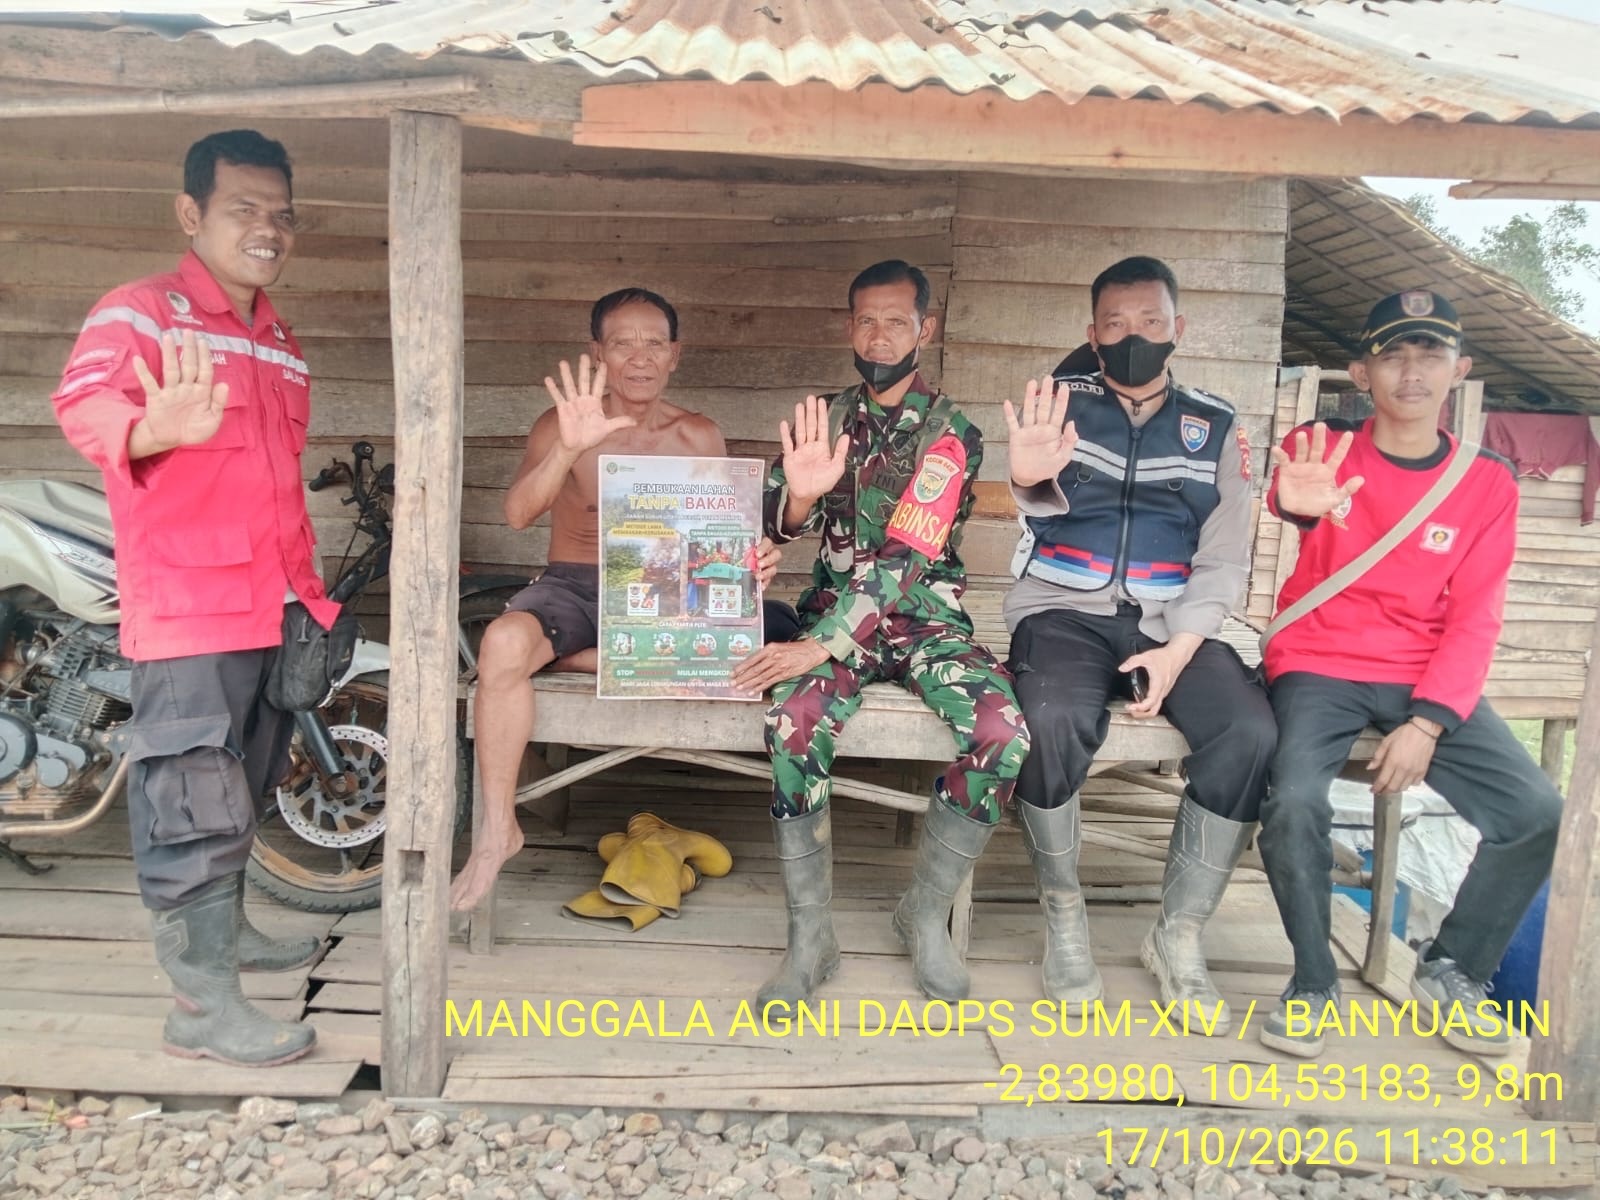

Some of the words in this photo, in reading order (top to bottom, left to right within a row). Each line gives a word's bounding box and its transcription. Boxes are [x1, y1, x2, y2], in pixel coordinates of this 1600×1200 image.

[1059, 382, 1104, 394] OLRI
[633, 483, 700, 494] PEMBUKAAN
[701, 484, 736, 496] LAHAN
[628, 496, 680, 510] TANPA
[685, 497, 737, 510] BAKAR
